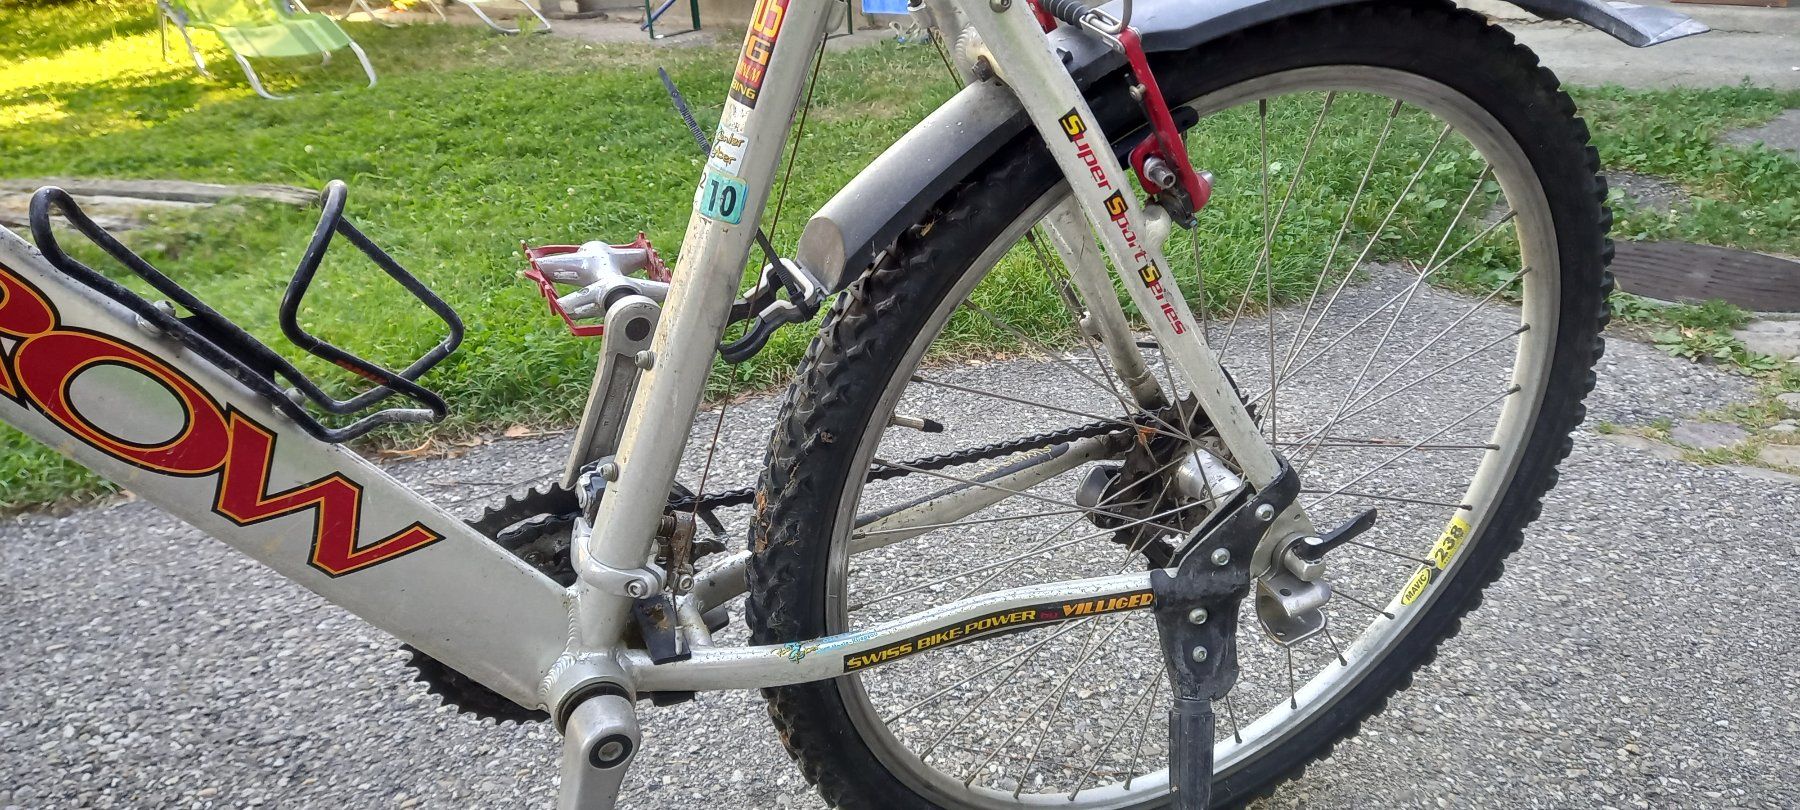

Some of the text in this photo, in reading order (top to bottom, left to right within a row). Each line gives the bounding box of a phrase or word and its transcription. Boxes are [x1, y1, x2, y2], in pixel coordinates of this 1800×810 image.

[708, 180, 737, 217] 10
[1062, 113, 1186, 335] Super Sport Series
[1405, 525, 1464, 601] MAVIC 238
[847, 641, 913, 669] SWISS
